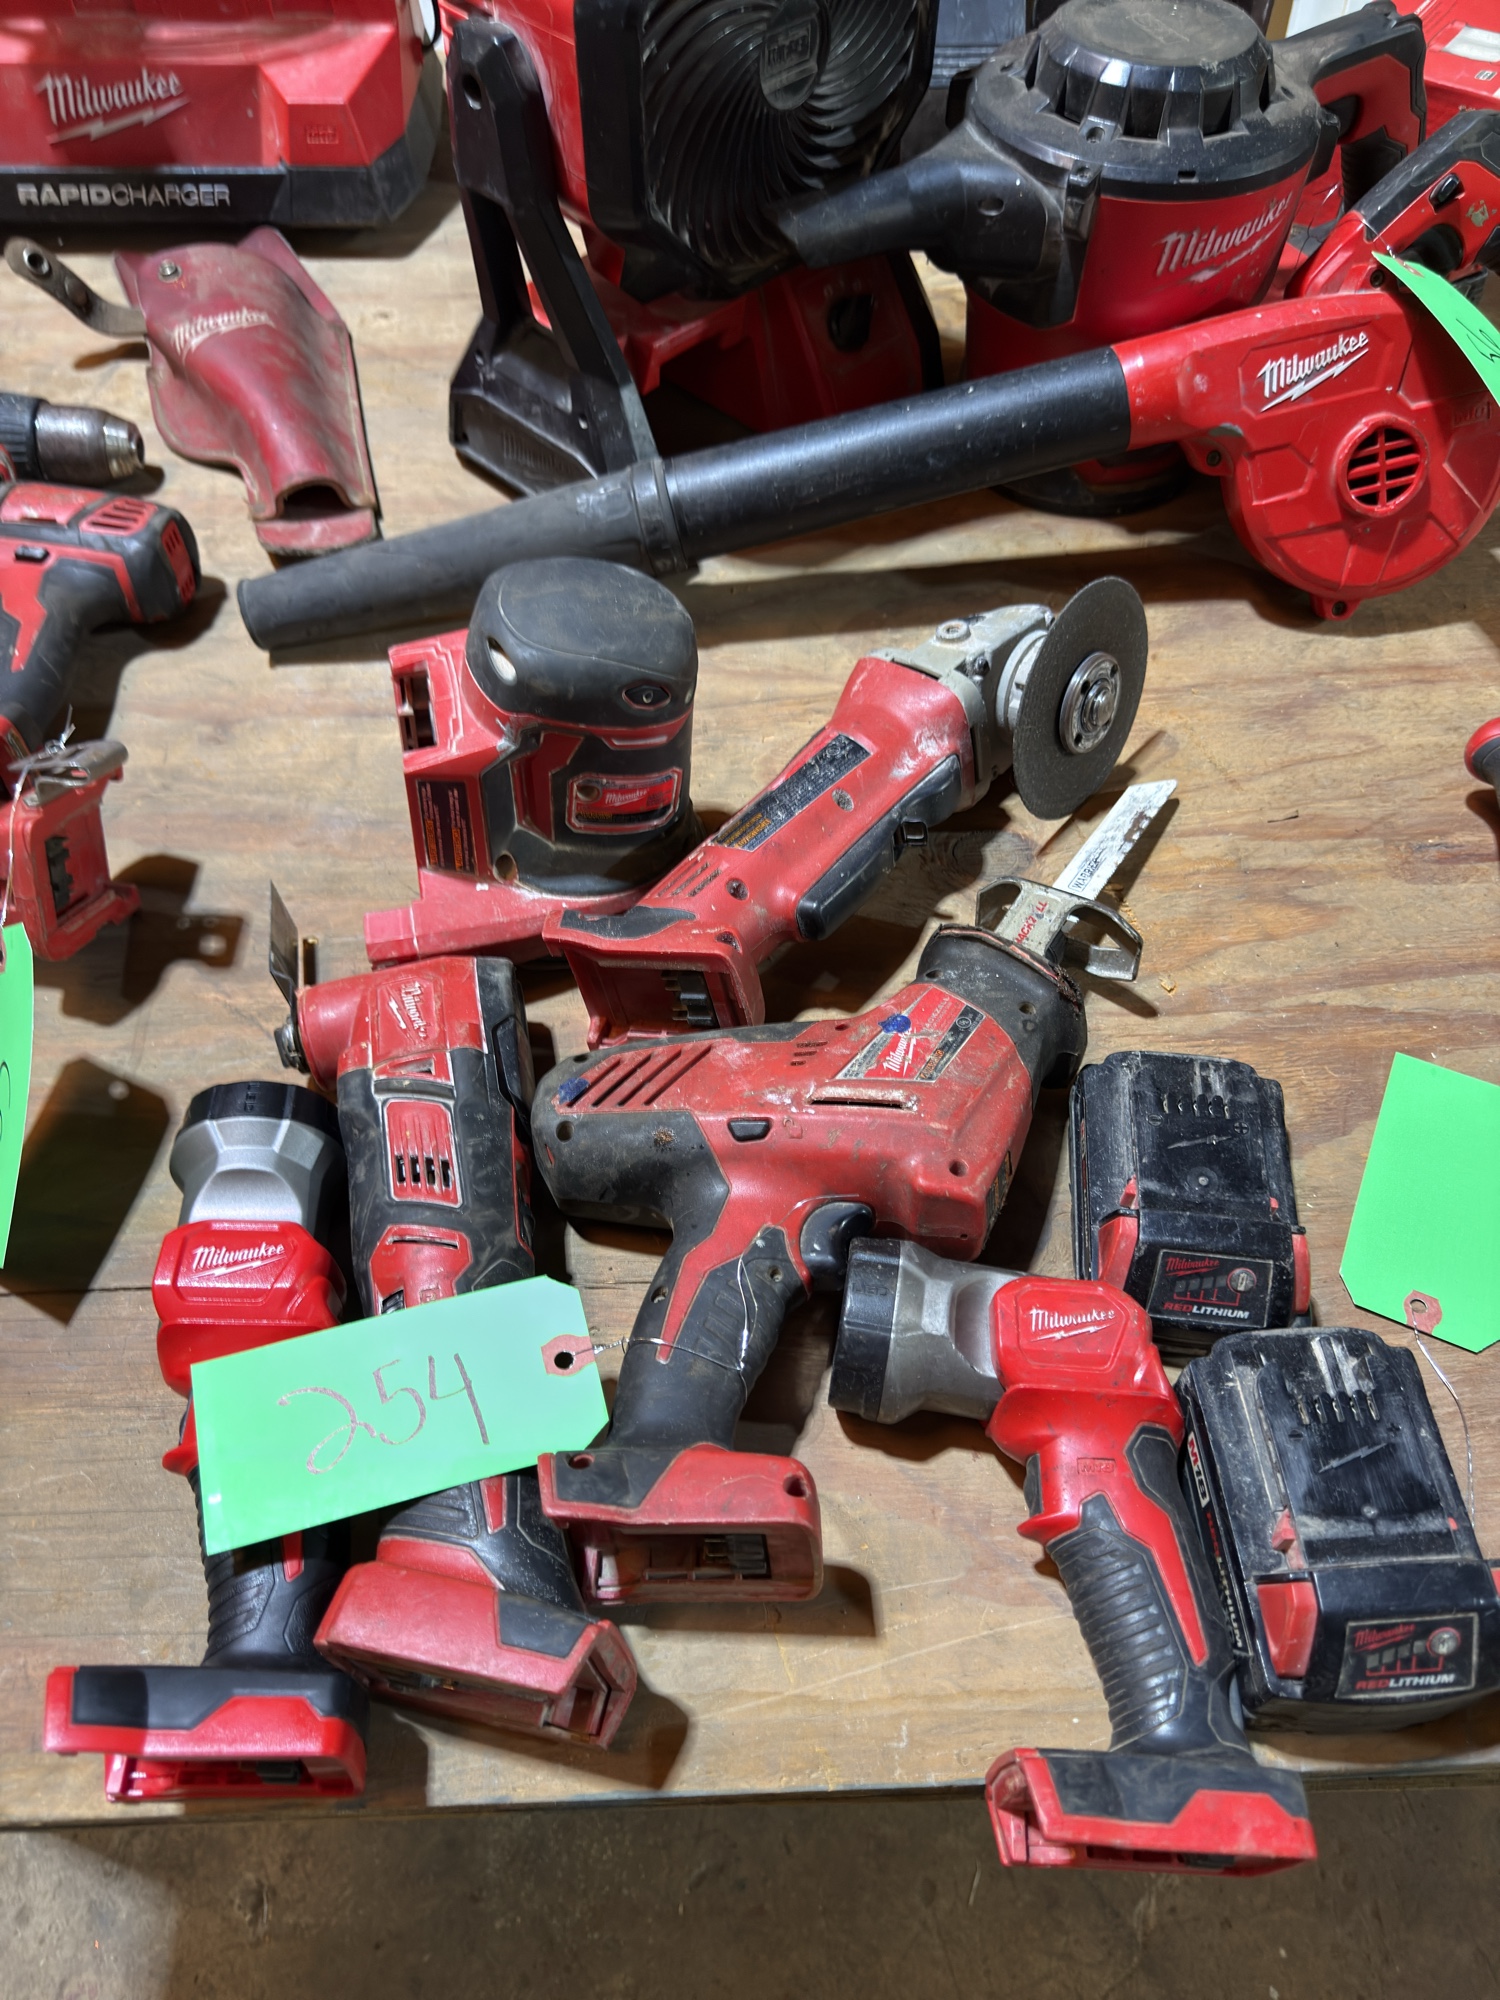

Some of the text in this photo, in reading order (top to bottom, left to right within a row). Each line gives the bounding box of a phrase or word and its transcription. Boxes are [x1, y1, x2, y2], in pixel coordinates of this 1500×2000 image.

[35, 66, 184, 126] Milwaukee
[16, 182, 231, 207] RAPIDCHARGER
[1256, 331, 1370, 398] Milwaukee
[605, 789, 648, 805] Milwaukee
[193, 1242, 285, 1272] Milwaukee
[1164, 1257, 1220, 1272] Milwaukee
[1028, 1308, 1116, 1332] Milwaukee
[1163, 1301, 1250, 1320] REDLITHIUM
[277, 1352, 490, 1475] 254
[1188, 1436, 1207, 1499] M18
[1354, 1623, 1416, 1648] Milwaukee
[1355, 1673, 1456, 1690] REDLITHIUM
